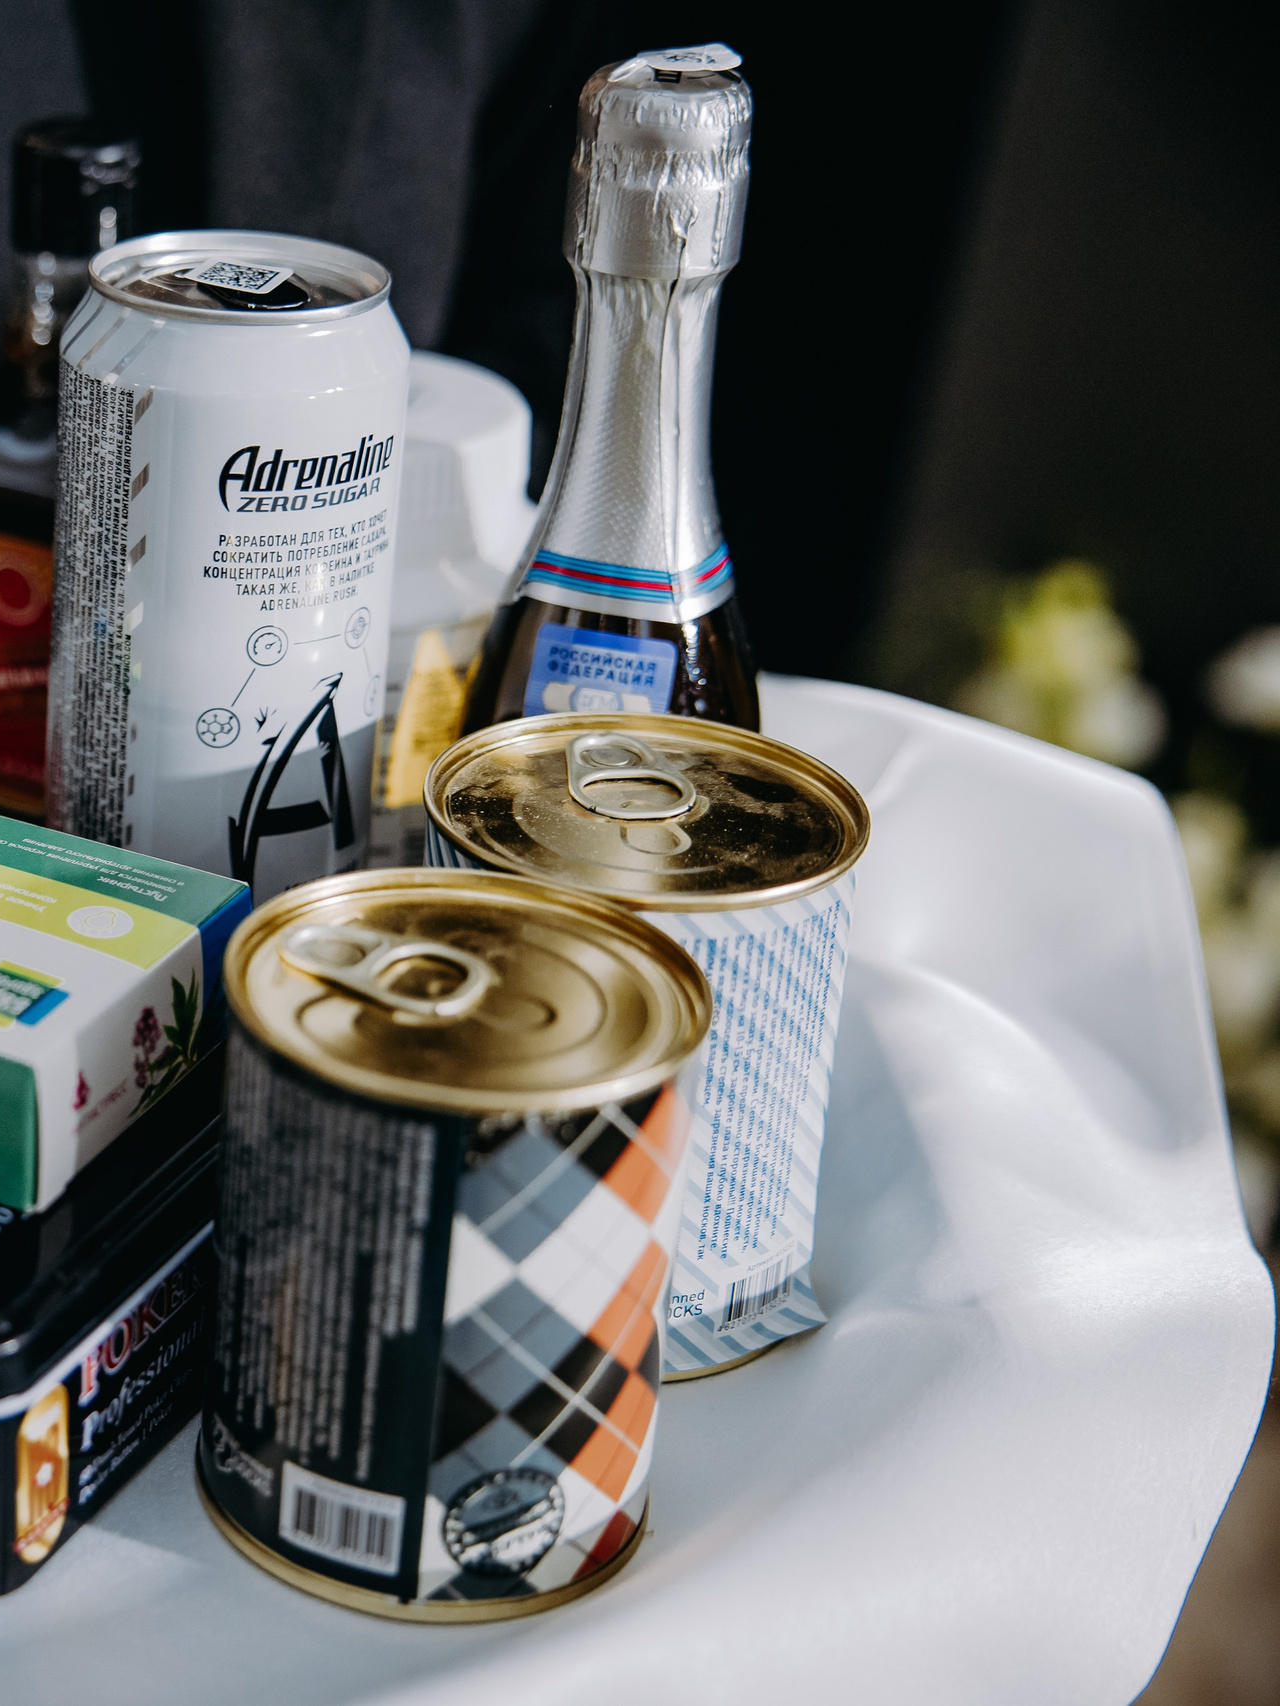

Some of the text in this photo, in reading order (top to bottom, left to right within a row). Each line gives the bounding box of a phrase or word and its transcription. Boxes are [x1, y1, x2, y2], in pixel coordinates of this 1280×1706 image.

[100, 382, 109, 442] ДОМОДЕДОВО,
[109, 384, 117, 414] 443028,
[116, 386, 125, 435] БЕЛАРУСЬ:
[108, 422, 115, 433] SA
[124, 388, 134, 457] ПОТРЕБИТЕЛЕЙ:
[107, 448, 114, 456] Д.
[114, 438, 123, 495] РЕСПУБЛИКЕ
[123, 458, 131, 476] ДЛЯ
[105, 457, 114, 521] КОСМОНАВТОВ,
[219, 435, 394, 512] Adrenaline
[97, 474, 105, 528] МОСКОВСКАЯ
[121, 476, 130, 519] КОНТАКТЫ
[237, 477, 380, 512] ZERO SUGAR
[111, 506, 119, 556] ПРЕТЕНЗИИ
[120, 533, 127, 541] 17
[220, 534, 297, 547] РАЗРАБОТАН
[301, 530, 324, 546] ДЛЯ
[329, 526, 347, 541] ТЕХ,
[351, 520, 365, 535] КТО
[119, 543, 127, 557] 590
[119, 558, 126, 566] 44
[203, 565, 300, 581] КОНЦЕНТРАЦИЯ
[355, 551, 361, 563] И
[213, 550, 282, 563] СОКРАТИТЬ
[288, 537, 359, 562] ПОТРЕБЛЕНИЕ
[101, 547, 110, 609] ЕКАТЕРИНБУРГ,
[107, 559, 118, 627] ПРИНИМАЮЩИЙ
[236, 583, 275, 596] ТАКАЯ
[279, 582, 300, 595] ЖЕ,
[330, 575, 336, 587] В
[339, 561, 375, 586] НАПИТКЕ
[260, 584, 358, 611] ADRENALINE RUSH.
[547, 660, 654, 686] ФЕДЕРАЦИЯ
[550, 646, 657, 673] РОССИЙСКАЯ
[6, 840, 47, 857] нервной
[21, 835, 67, 853] давления
[63, 846, 133, 872] артериального
[44, 850, 101, 872] укрепления
[97, 866, 119, 876] для
[131, 867, 178, 884] снижения
[93, 873, 170, 902] Пустырник
[116, 870, 178, 894] применяется
[2, 894, 48, 913] Умное
[759, 1012, 768, 1041] стали
[702, 1043, 716, 1108] владельцем.
[716, 1065, 727, 1106] степень
[725, 1076, 739, 1123] закройте
[747, 1097, 759, 1139] Степень
[707, 1107, 721, 1169] загрязнения
[722, 1125, 731, 1152] глаза
[722, 1048, 754, 1259] Будьте предельно осторожны!!! Поднесите
[716, 1162, 728, 1201] глубоко
[739, 1142, 751, 1201] загрязнения
[751, 1143, 762, 1187] большая
[704, 1171, 713, 1203] ваших
[699, 1205, 709, 1242] носков,
[711, 1203, 722, 1250] вдохните.
[735, 1204, 743, 1240] можете
[741, 1190, 755, 1253] вероятность,
[672, 1290, 705, 1305] nned
